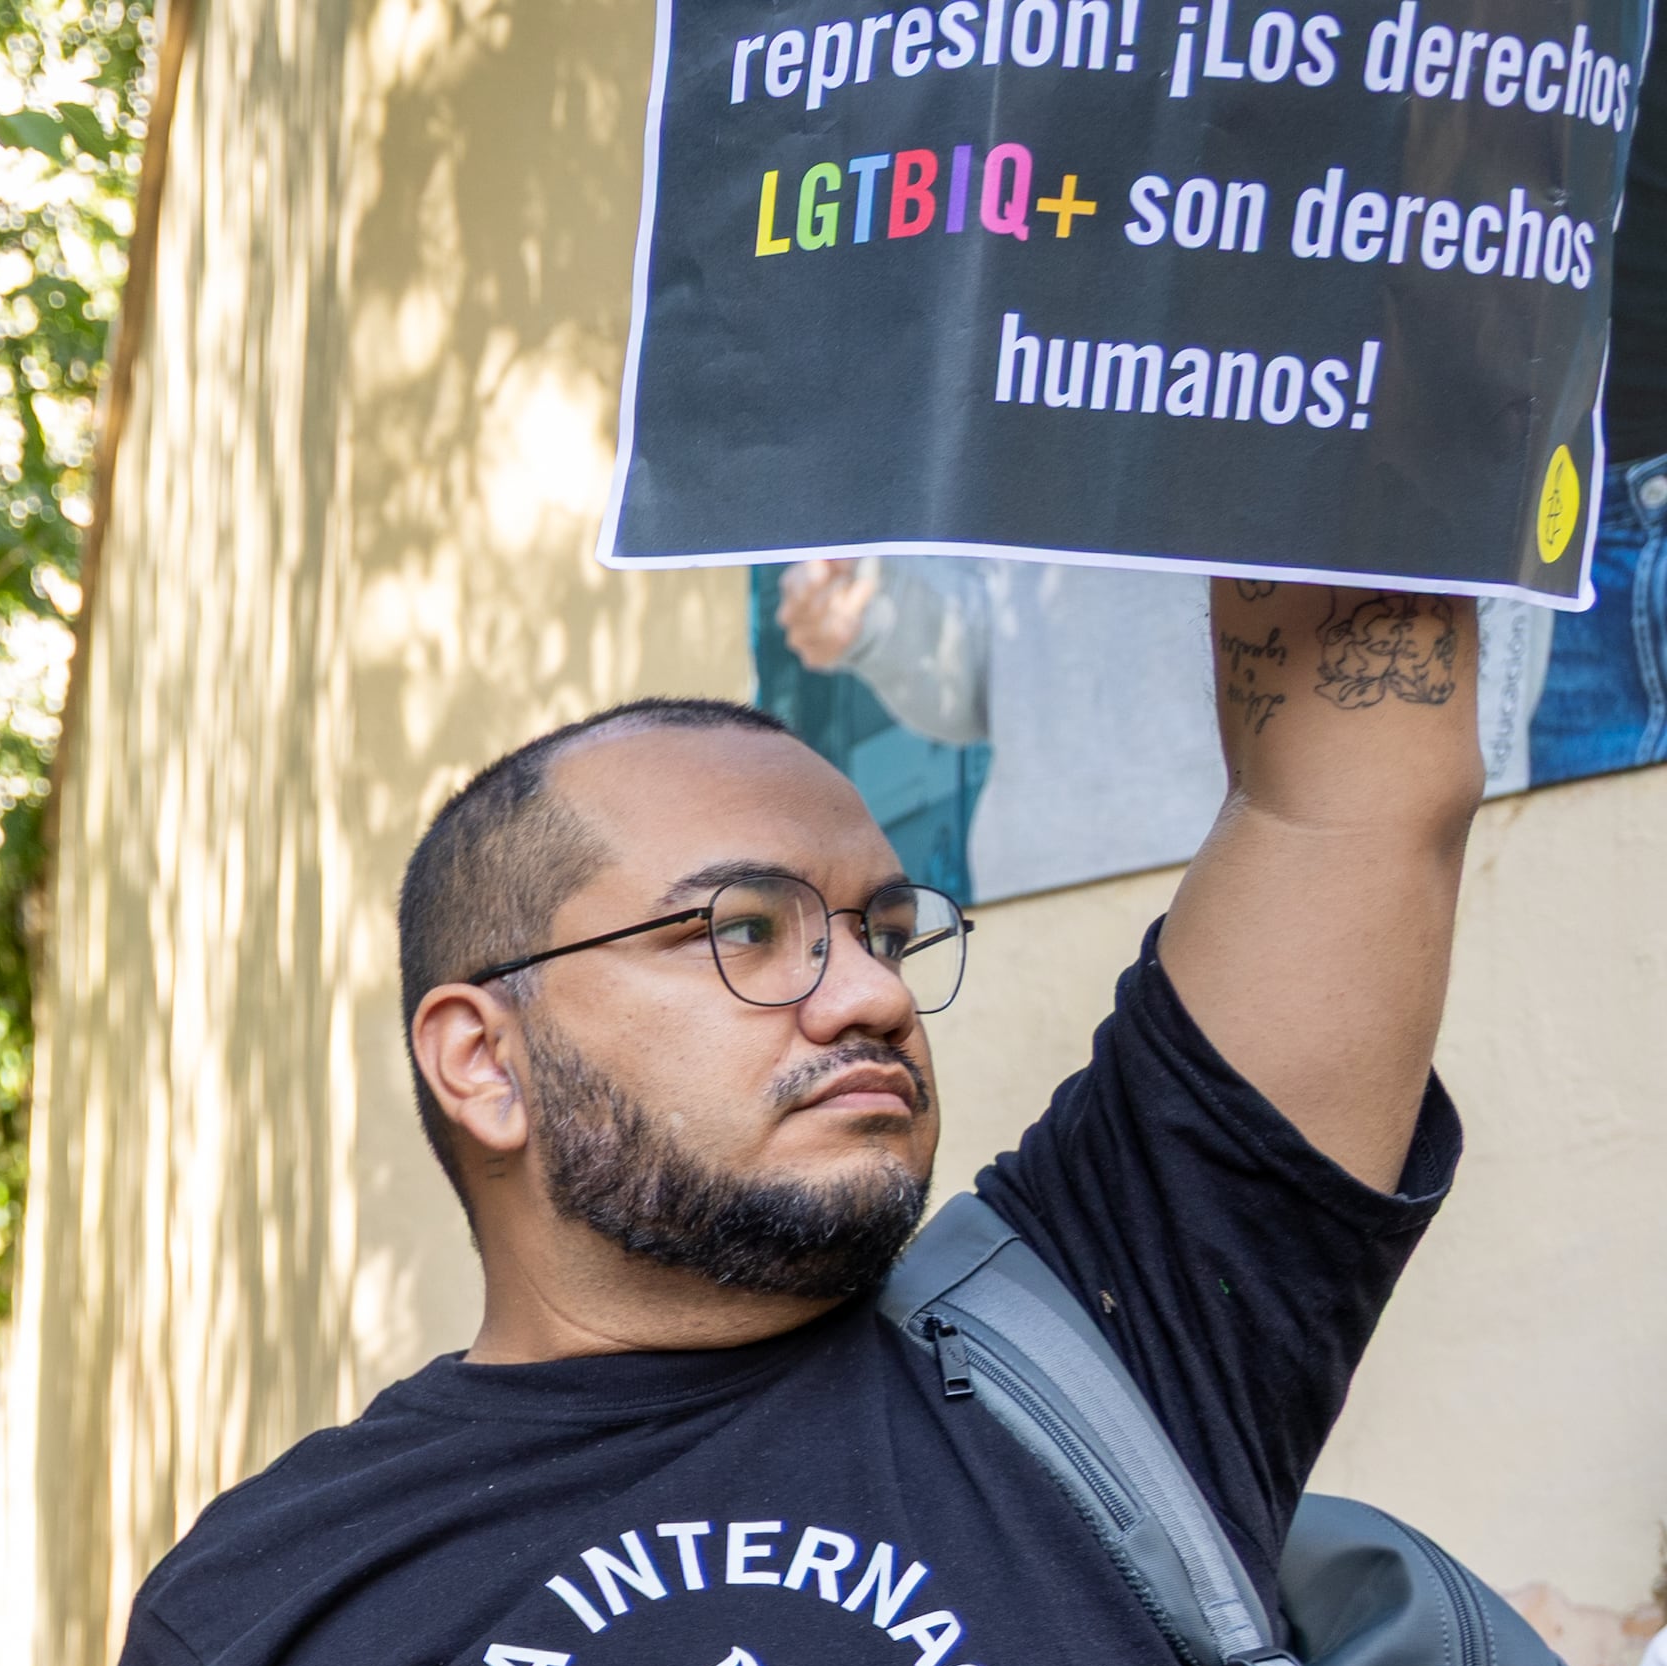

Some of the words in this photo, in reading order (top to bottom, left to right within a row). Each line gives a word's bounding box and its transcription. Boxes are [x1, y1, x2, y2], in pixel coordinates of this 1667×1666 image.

[1169, 0, 1341, 98] ¡Los
[1364, 0, 1630, 132] derechos
[755, 143, 1096, 256] LGTBIQ+
[1124, 175, 1266, 252] son
[1292, 168, 1594, 289] derechos
[995, 313, 1380, 429] humanos!
